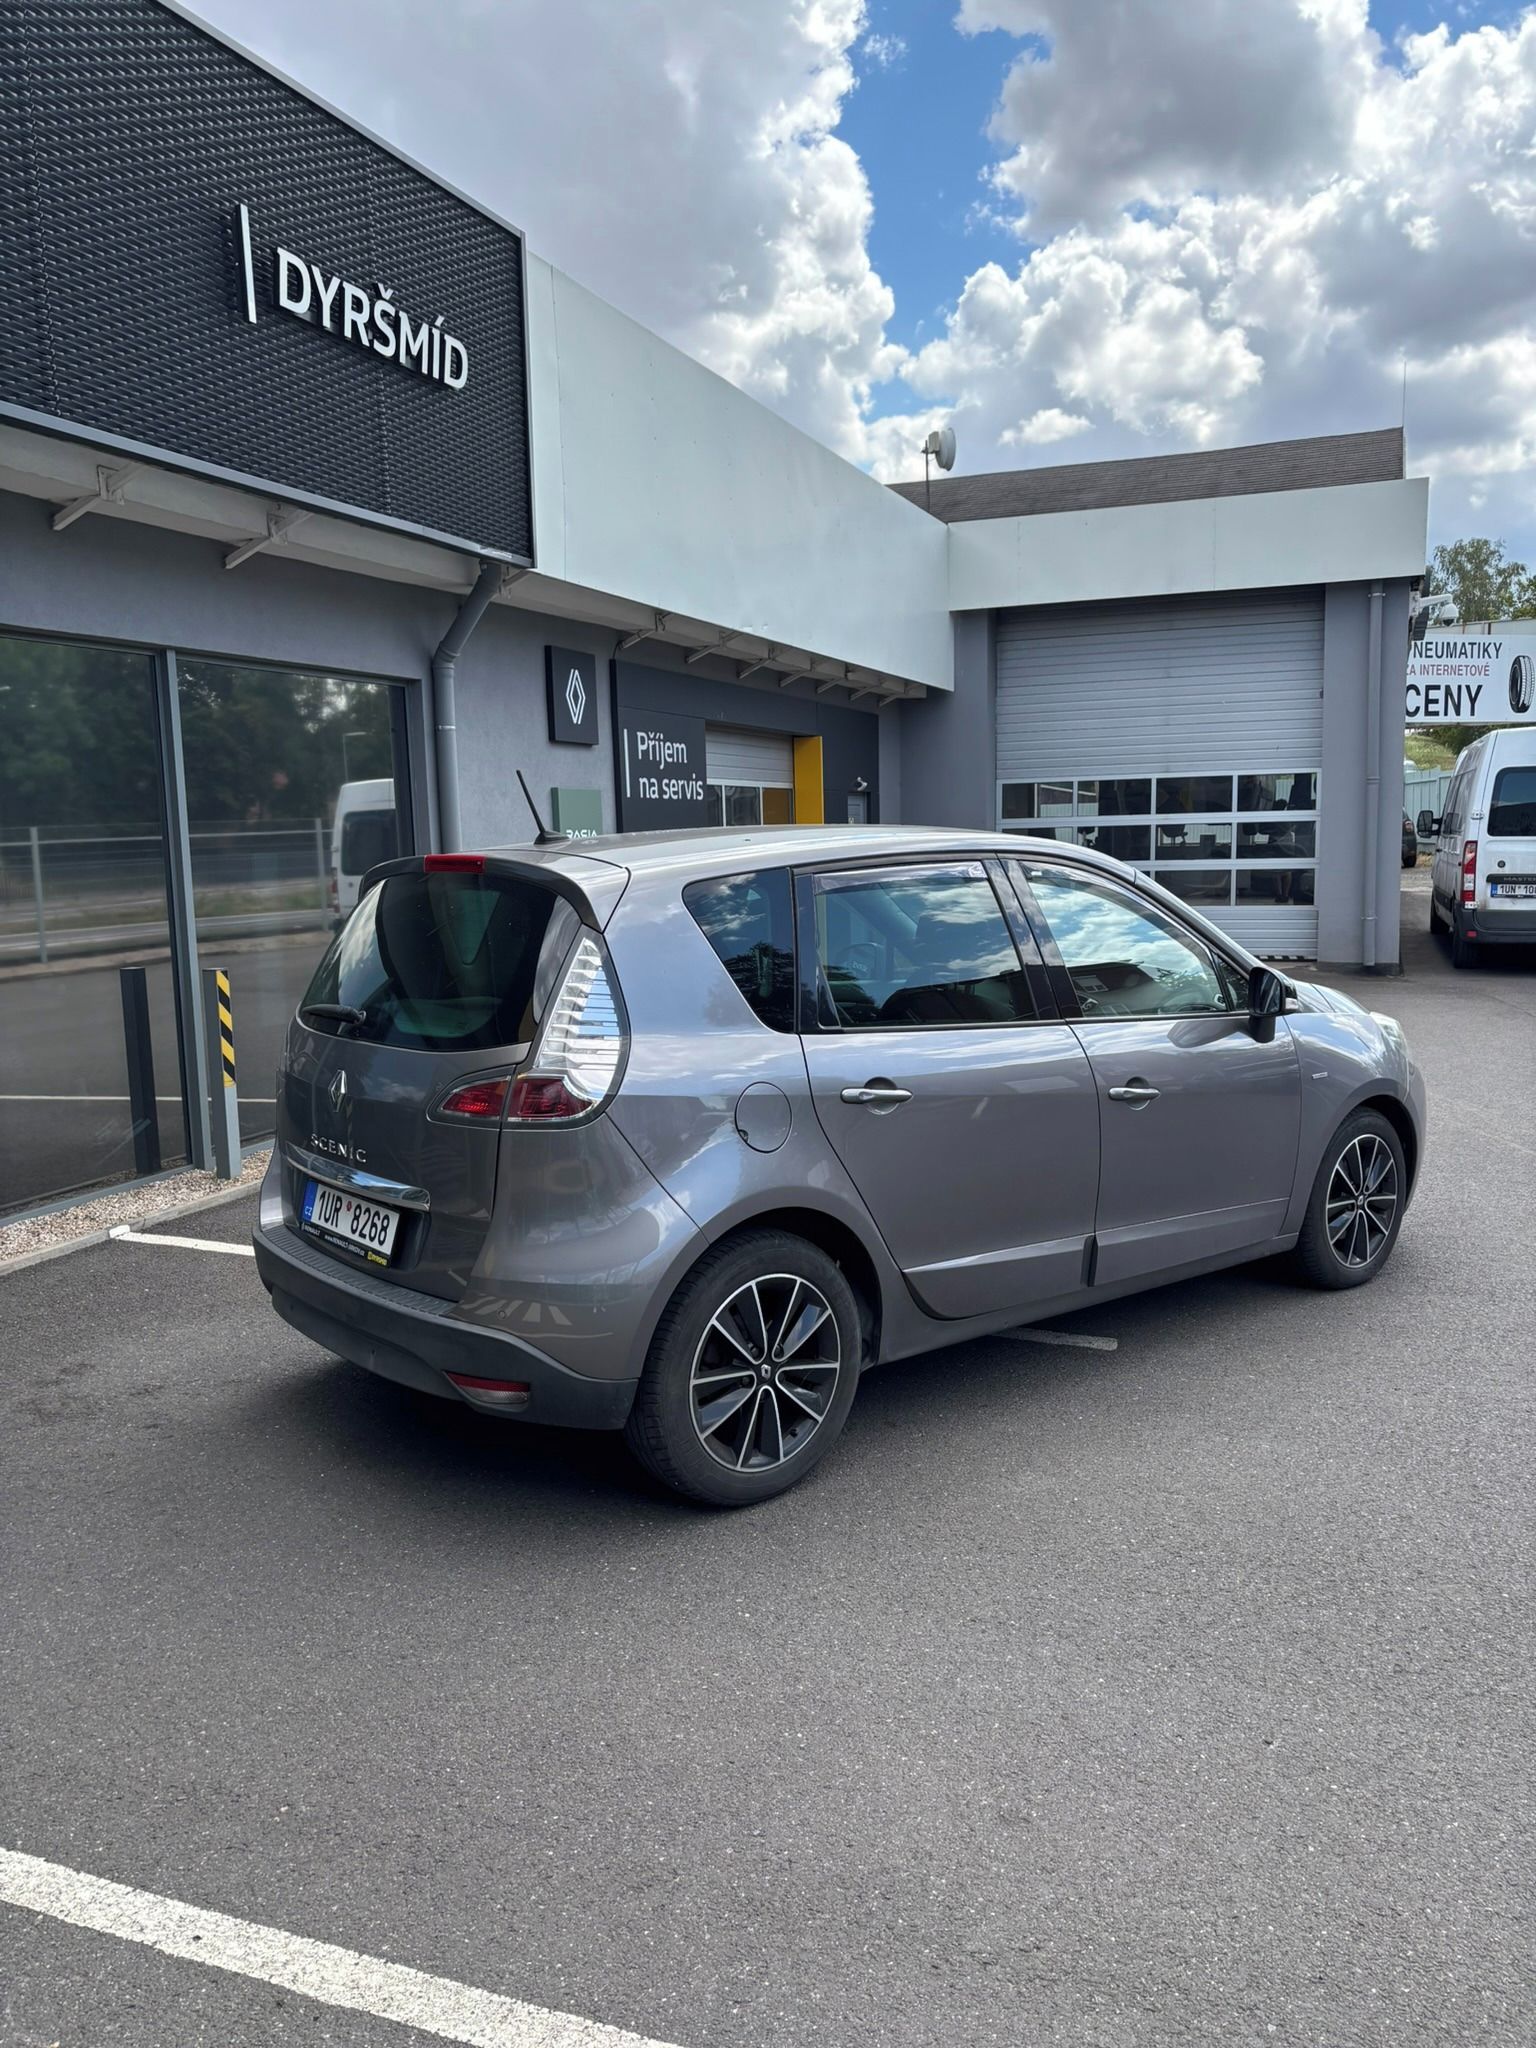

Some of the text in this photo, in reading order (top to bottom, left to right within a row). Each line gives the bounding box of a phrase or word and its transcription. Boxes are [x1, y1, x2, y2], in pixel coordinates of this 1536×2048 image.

[277, 247, 469, 390] DYRŠMÍD
[1412, 641, 1503, 660] NEUMATIKY
[1420, 662, 1490, 677] INTERNETOVÉ
[1405, 683, 1484, 718] CENY
[636, 731, 688, 770] Příjem
[638, 773, 704, 801] na servis
[1524, 885, 1536, 894] 10
[310, 1133, 368, 1163] SCENIC
[318, 1190, 343, 1229] 1UR
[350, 1203, 391, 1247] 8268
